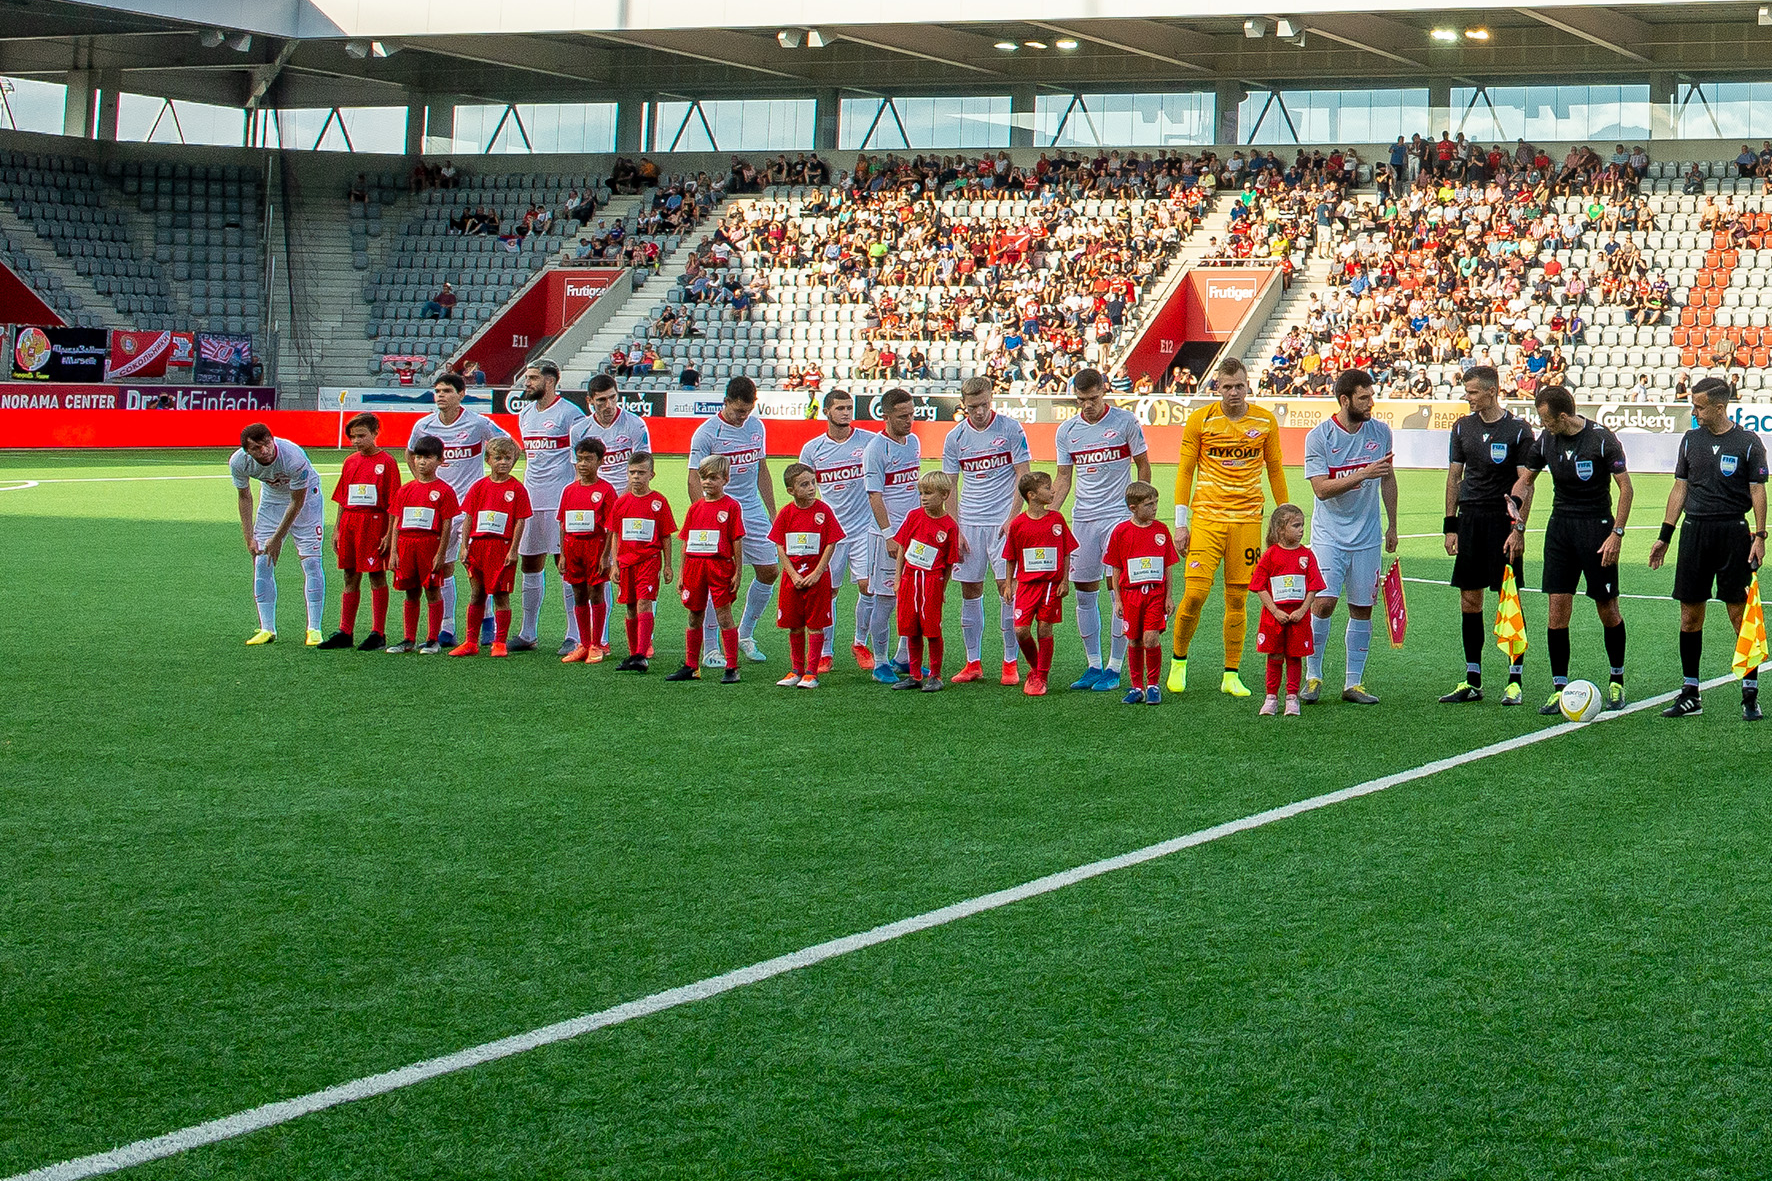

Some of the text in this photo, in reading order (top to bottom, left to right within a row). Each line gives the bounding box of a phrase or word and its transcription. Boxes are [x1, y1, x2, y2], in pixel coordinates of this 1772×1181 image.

[1209, 286, 1254, 301] Frutiger
[512, 334, 528, 347] E11
[1160, 339, 1174, 353] E12
[119, 334, 169, 376] СОКОЛЬНИКИ
[65, 394, 115, 409] CENTER
[674, 403, 693, 412] auto
[1369, 411, 1394, 419] ADIO
[1596, 405, 1676, 432] Carlsberg
[524, 438, 557, 450] УКОЙЛ
[1075, 449, 1120, 464] ЛУКОЙЛ
[1208, 447, 1260, 459] ЛУКОЙЛ
[892, 470, 919, 484] ЛУКО
[1244, 548, 1261, 565] 98
